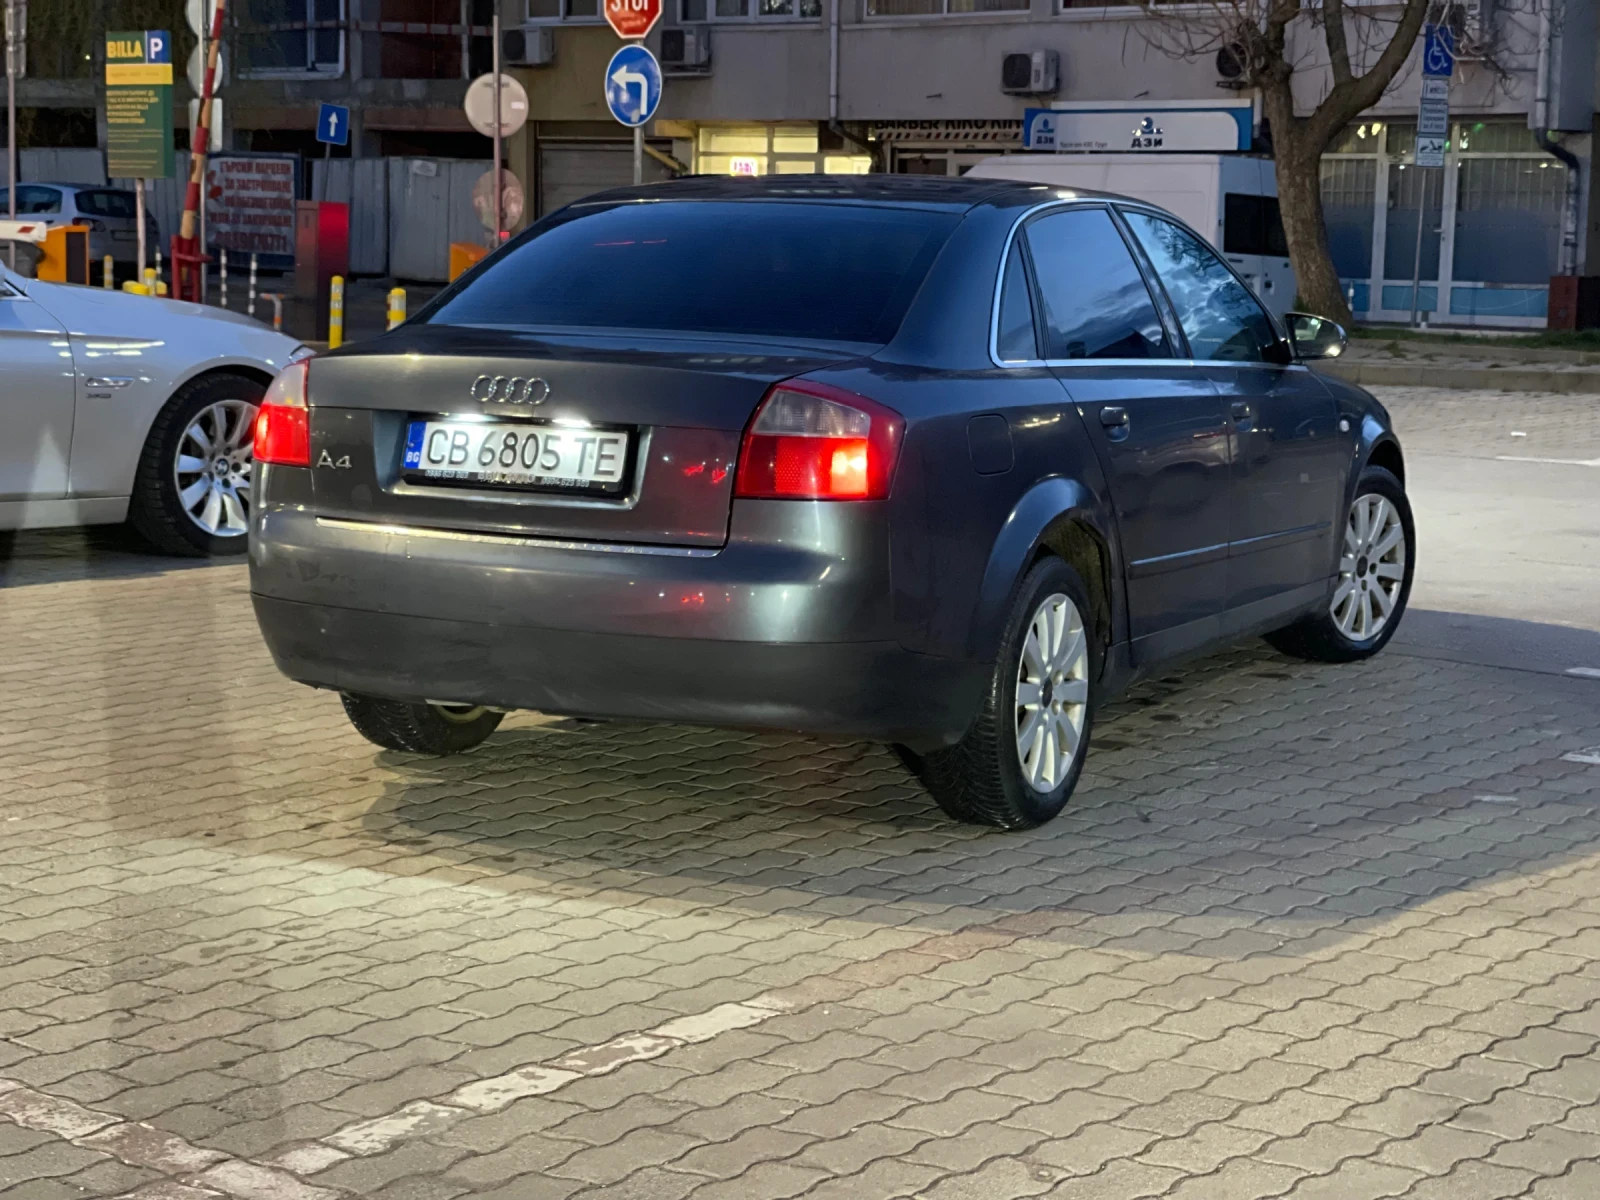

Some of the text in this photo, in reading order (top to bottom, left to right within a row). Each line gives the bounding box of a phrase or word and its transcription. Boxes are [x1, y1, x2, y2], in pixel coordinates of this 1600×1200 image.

[106, 37, 163, 59] BILLA P
[875, 119, 939, 130] BARBER
[1036, 136, 1054, 144] ДЗИ
[1131, 138, 1163, 148] ДЗИ
[405, 452, 420, 463] BG
[427, 428, 620, 476] CB 6805 TE
[316, 449, 352, 469] A4
